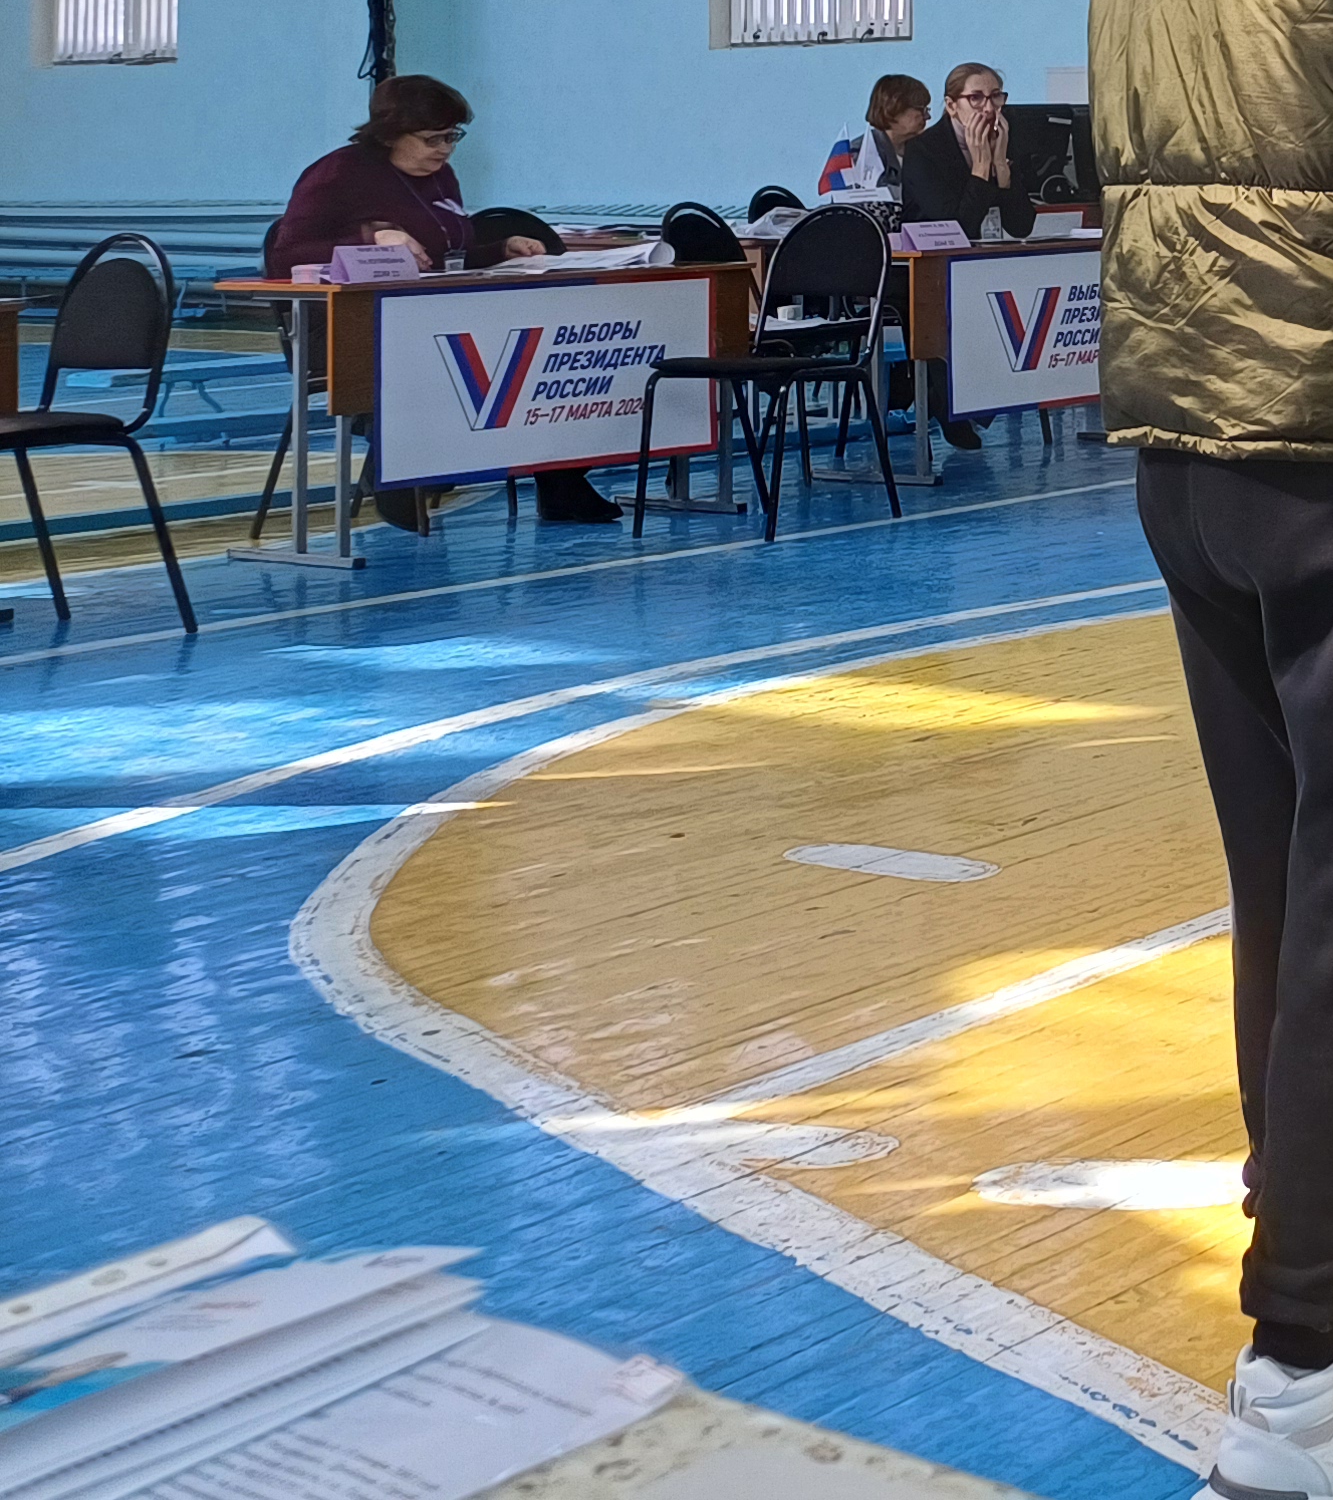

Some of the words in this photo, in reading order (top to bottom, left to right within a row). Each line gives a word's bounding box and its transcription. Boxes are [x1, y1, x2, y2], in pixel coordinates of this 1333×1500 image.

[1067, 284, 1100, 302] ВЫБ
[553, 320, 642, 345] ВЫБОРЫ
[1053, 327, 1100, 348] РОССИ
[542, 344, 666, 373] ПРЕЗИДЕНТА
[1075, 349, 1100, 365] МАР
[531, 375, 614, 401] РОССИИ
[565, 400, 612, 422] МАРТА
